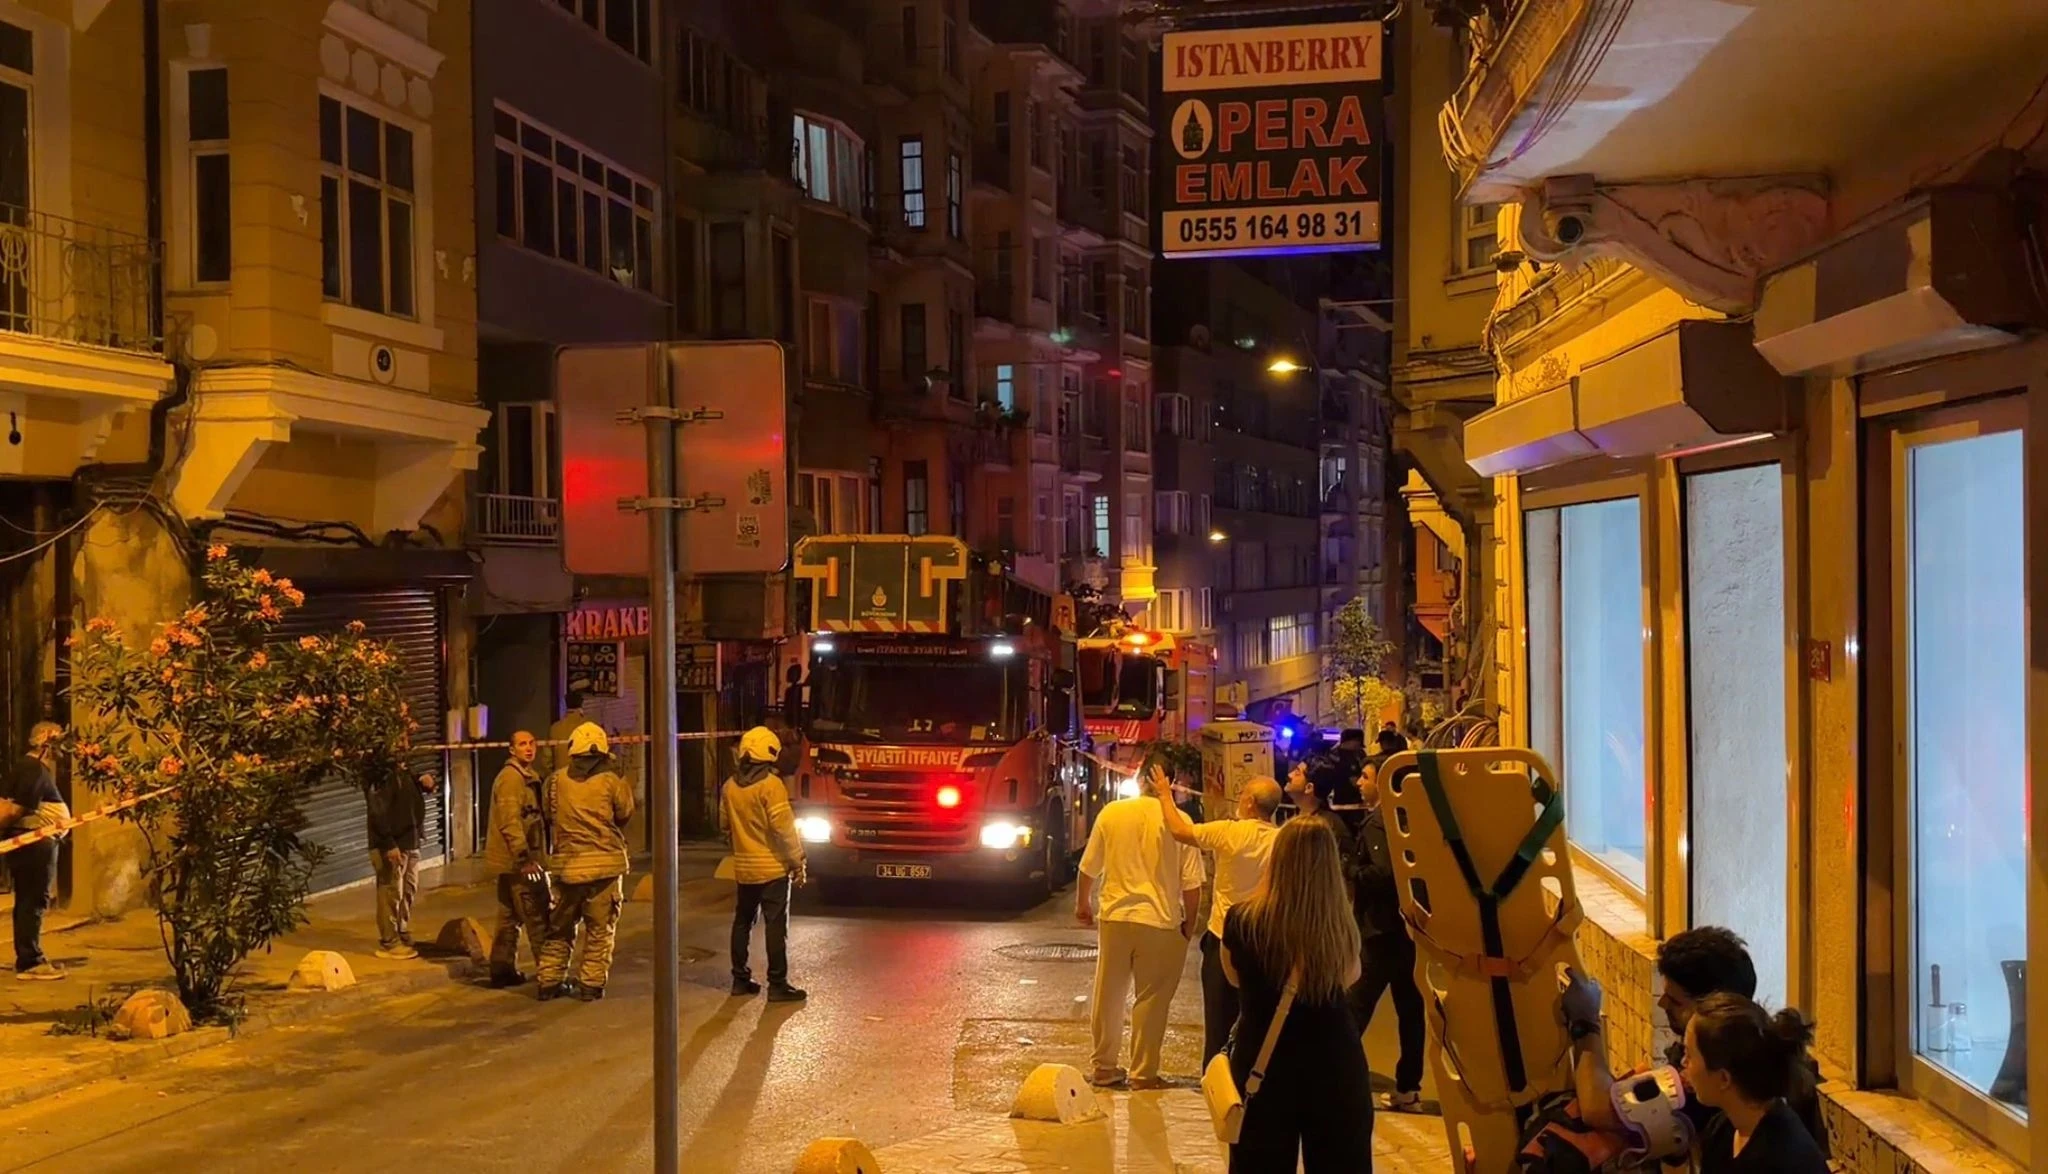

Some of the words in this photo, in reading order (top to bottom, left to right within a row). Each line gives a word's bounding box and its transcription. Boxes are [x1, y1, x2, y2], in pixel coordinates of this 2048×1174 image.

[1175, 35, 1373, 78] ISTANBERRY
[1217, 95, 1371, 153] PERA
[1175, 155, 1368, 204] EMLAK
[1179, 215, 1237, 243] 0555
[1245, 213, 1289, 241] 164
[1296, 212, 1326, 238] 98
[1334, 210, 1362, 237] 31
